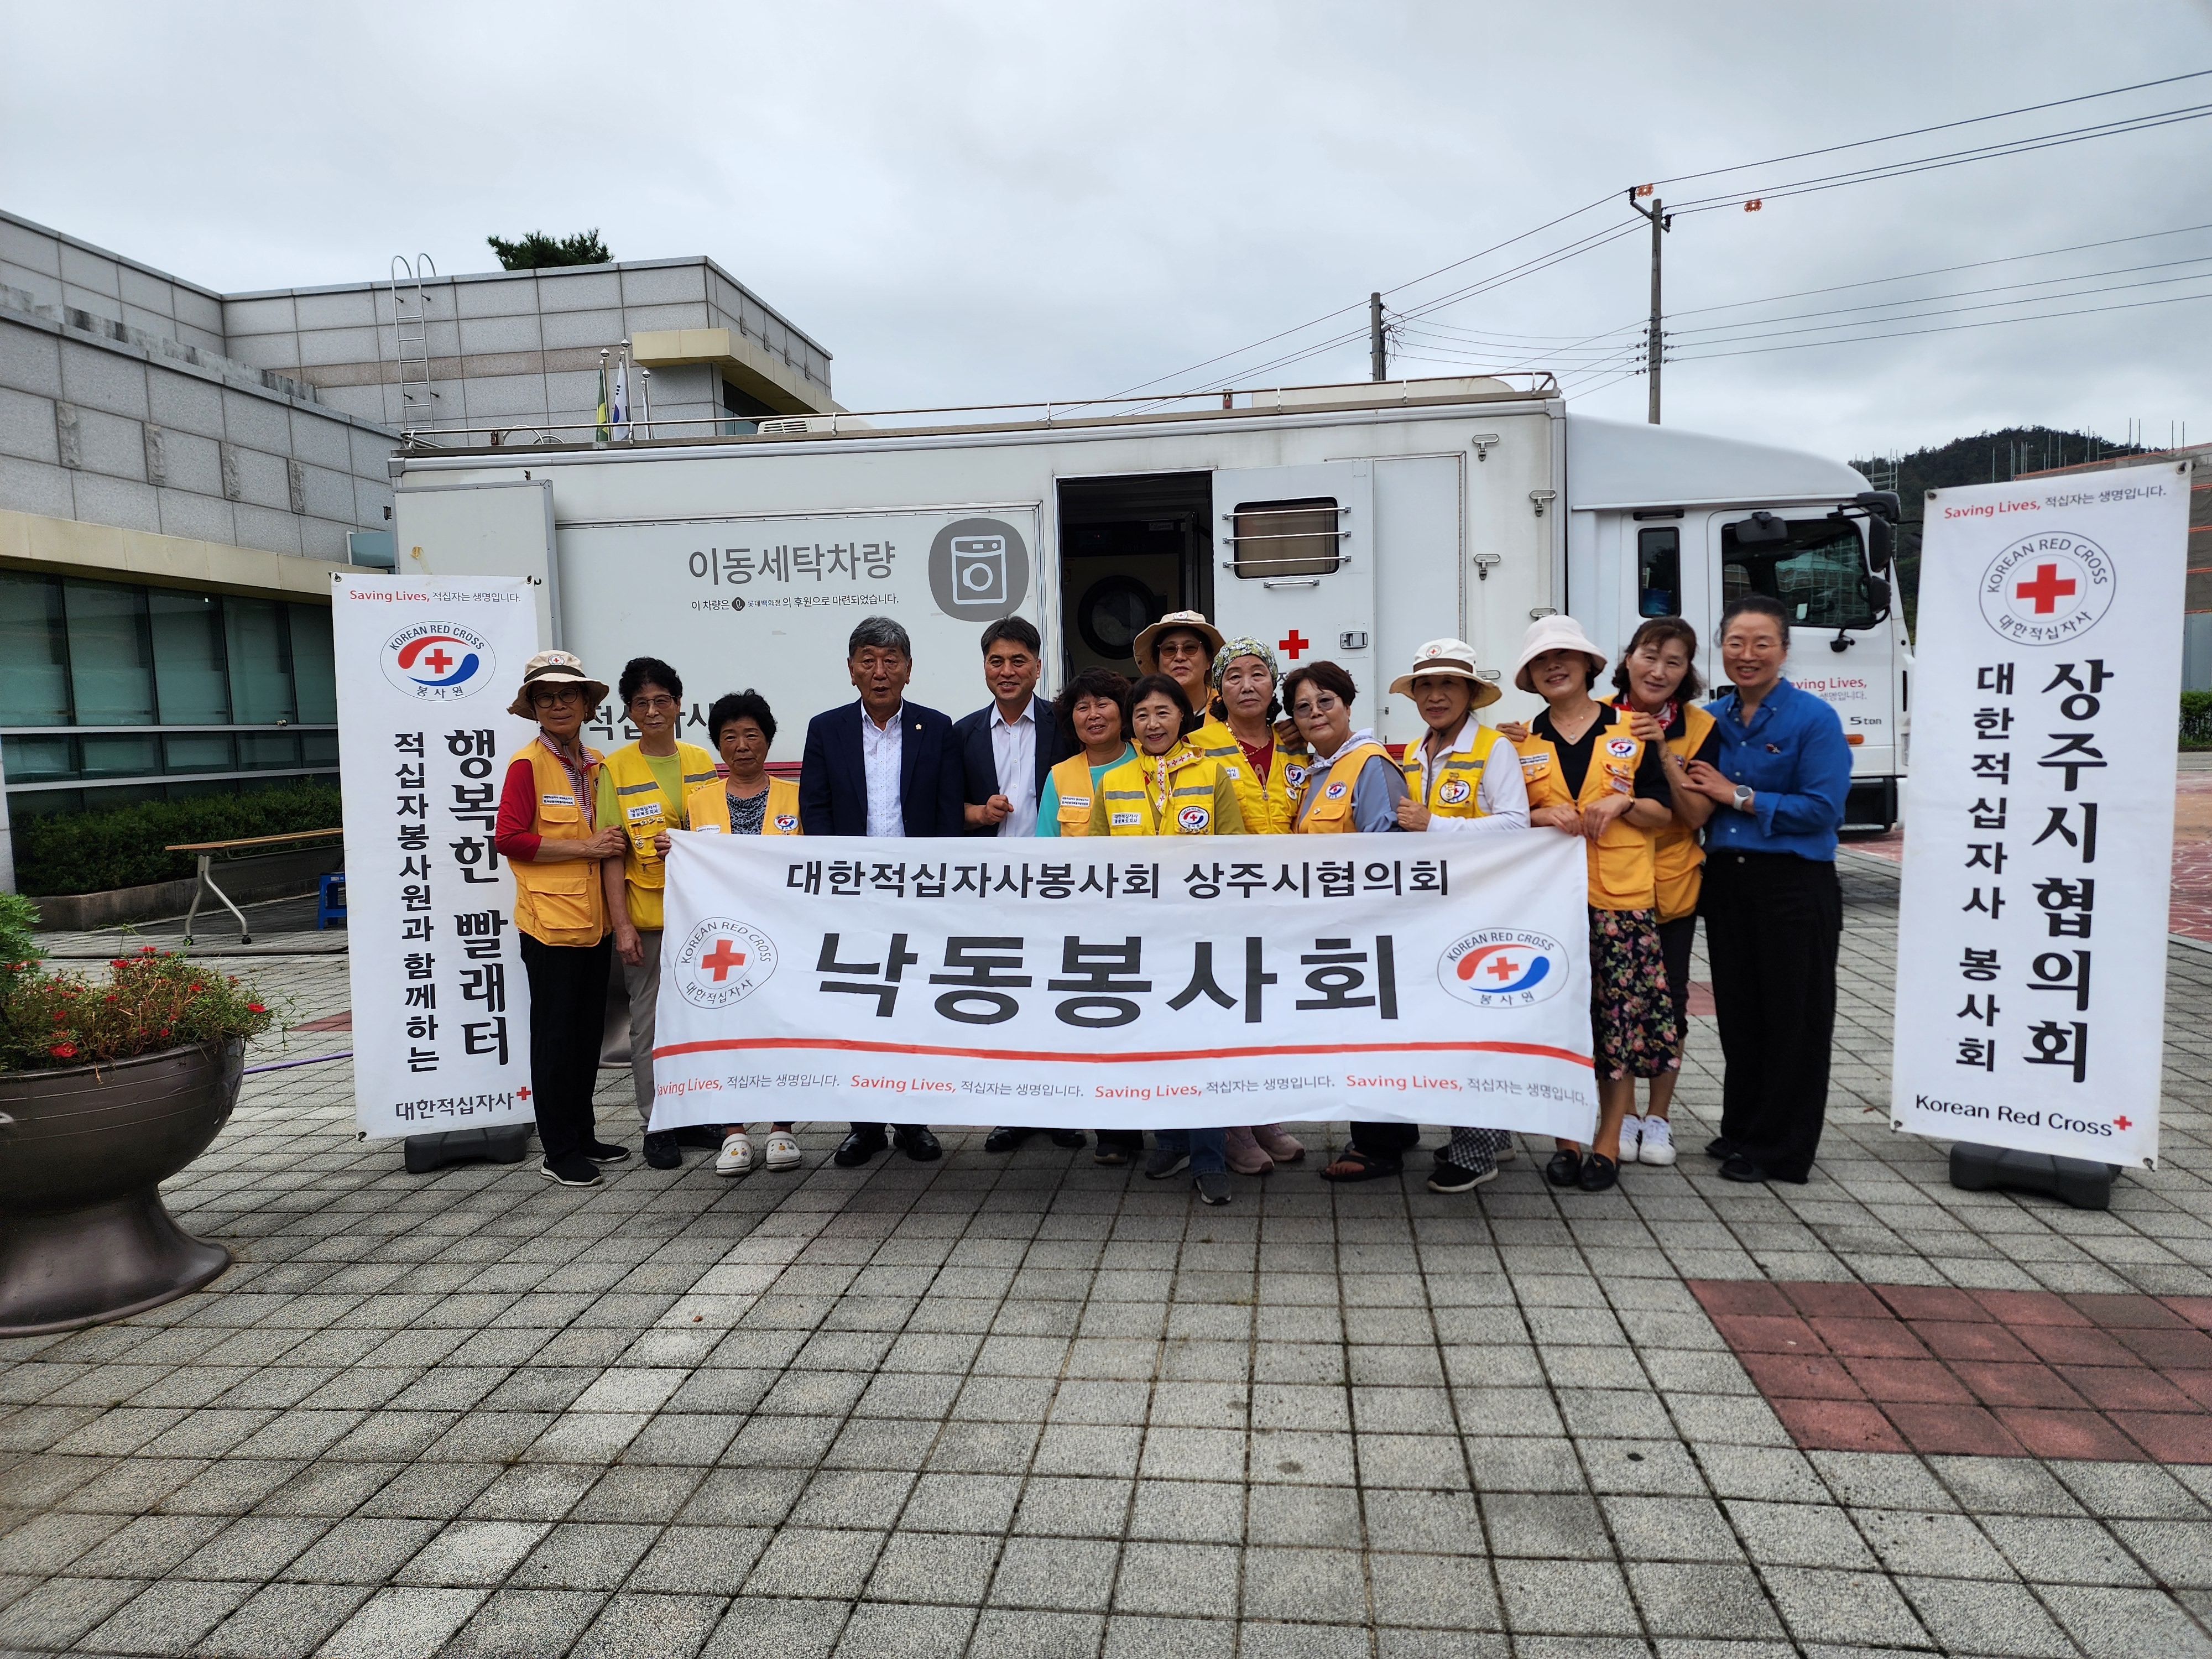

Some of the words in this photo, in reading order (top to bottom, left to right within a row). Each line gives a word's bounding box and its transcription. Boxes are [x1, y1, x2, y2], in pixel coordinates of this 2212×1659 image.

[1945, 505, 1994, 519] Saving
[1999, 501, 2040, 512] Lives,
[2046, 494, 2094, 507] 적십자는
[2099, 485, 2166, 502] 생명입니다.
[689, 541, 895, 585] 이동세탁차량
[1987, 543, 2033, 593] KOREAN
[2039, 539, 2071, 550] RED
[2073, 544, 2108, 585] CROSS
[350, 591, 392, 602] Saving
[397, 591, 430, 602] Lives,
[433, 592, 470, 601] 적십자는
[473, 593, 520, 602] 생명입니다.
[692, 601, 700, 611] 이
[703, 600, 729, 611] 차량은
[794, 597, 830, 607] 후원으로
[833, 593, 899, 606] 마련되었습니다.
[389, 625, 427, 651] KOREAN
[430, 625, 450, 633] RED
[453, 628, 485, 651] CROSS
[1998, 611, 2093, 641] 대한적십자사
[1829, 677, 1867, 688] Lives,
[444, 729, 499, 883] 행복한
[1962, 662, 2014, 919] 대한적십자사
[394, 732, 434, 942] 적십자봉사원과
[786, 861, 1159, 899] 대한적십자사봉사회
[1183, 860, 1447, 899] 상주시협의회
[2023, 659, 2114, 1083] 상주시협의회
[681, 922, 717, 963] KOREAN
[722, 922, 748, 934] RED
[749, 934, 771, 962] CROSS
[1447, 933, 1488, 962] KOREAN
[1491, 932, 1512, 942] RED
[1517, 933, 1554, 951] CROSS
[453, 910, 508, 1065] 빨래터
[686, 979, 753, 1004] 대한적십자사
[816, 933, 1398, 1028] 낙동봉사회
[403, 953, 439, 1072] 함께하는
[1956, 947, 2001, 1072] 봉사회
[396, 1093, 514, 1120] 대한적십자사
[688, 1078, 722, 1091] Lives,
[727, 1075, 771, 1089] 적십자는
[776, 1074, 839, 1087] 생명입니다.
[851, 1076, 906, 1092] Saving
[911, 1079, 956, 1093] Lives,
[961, 1081, 1011, 1095] 적십자는
[1016, 1084, 1083, 1097] 생명입니다.
[1095, 1086, 1150, 1100] Saving
[1157, 1085, 1202, 1096] Lives,
[1207, 1080, 1259, 1094] 적십자는
[1264, 1076, 1334, 1090] 생명입니다.
[1347, 1076, 1406, 1091] Saving
[1413, 1076, 1462, 1091] Lives,
[1468, 1078, 1522, 1094] 적십자는
[1527, 1084, 1588, 1106] 생명입니다.
[1916, 1095, 1989, 1119] Korean
[1999, 1106, 2039, 1126] Red
[2048, 1113, 2112, 1136] Cross
